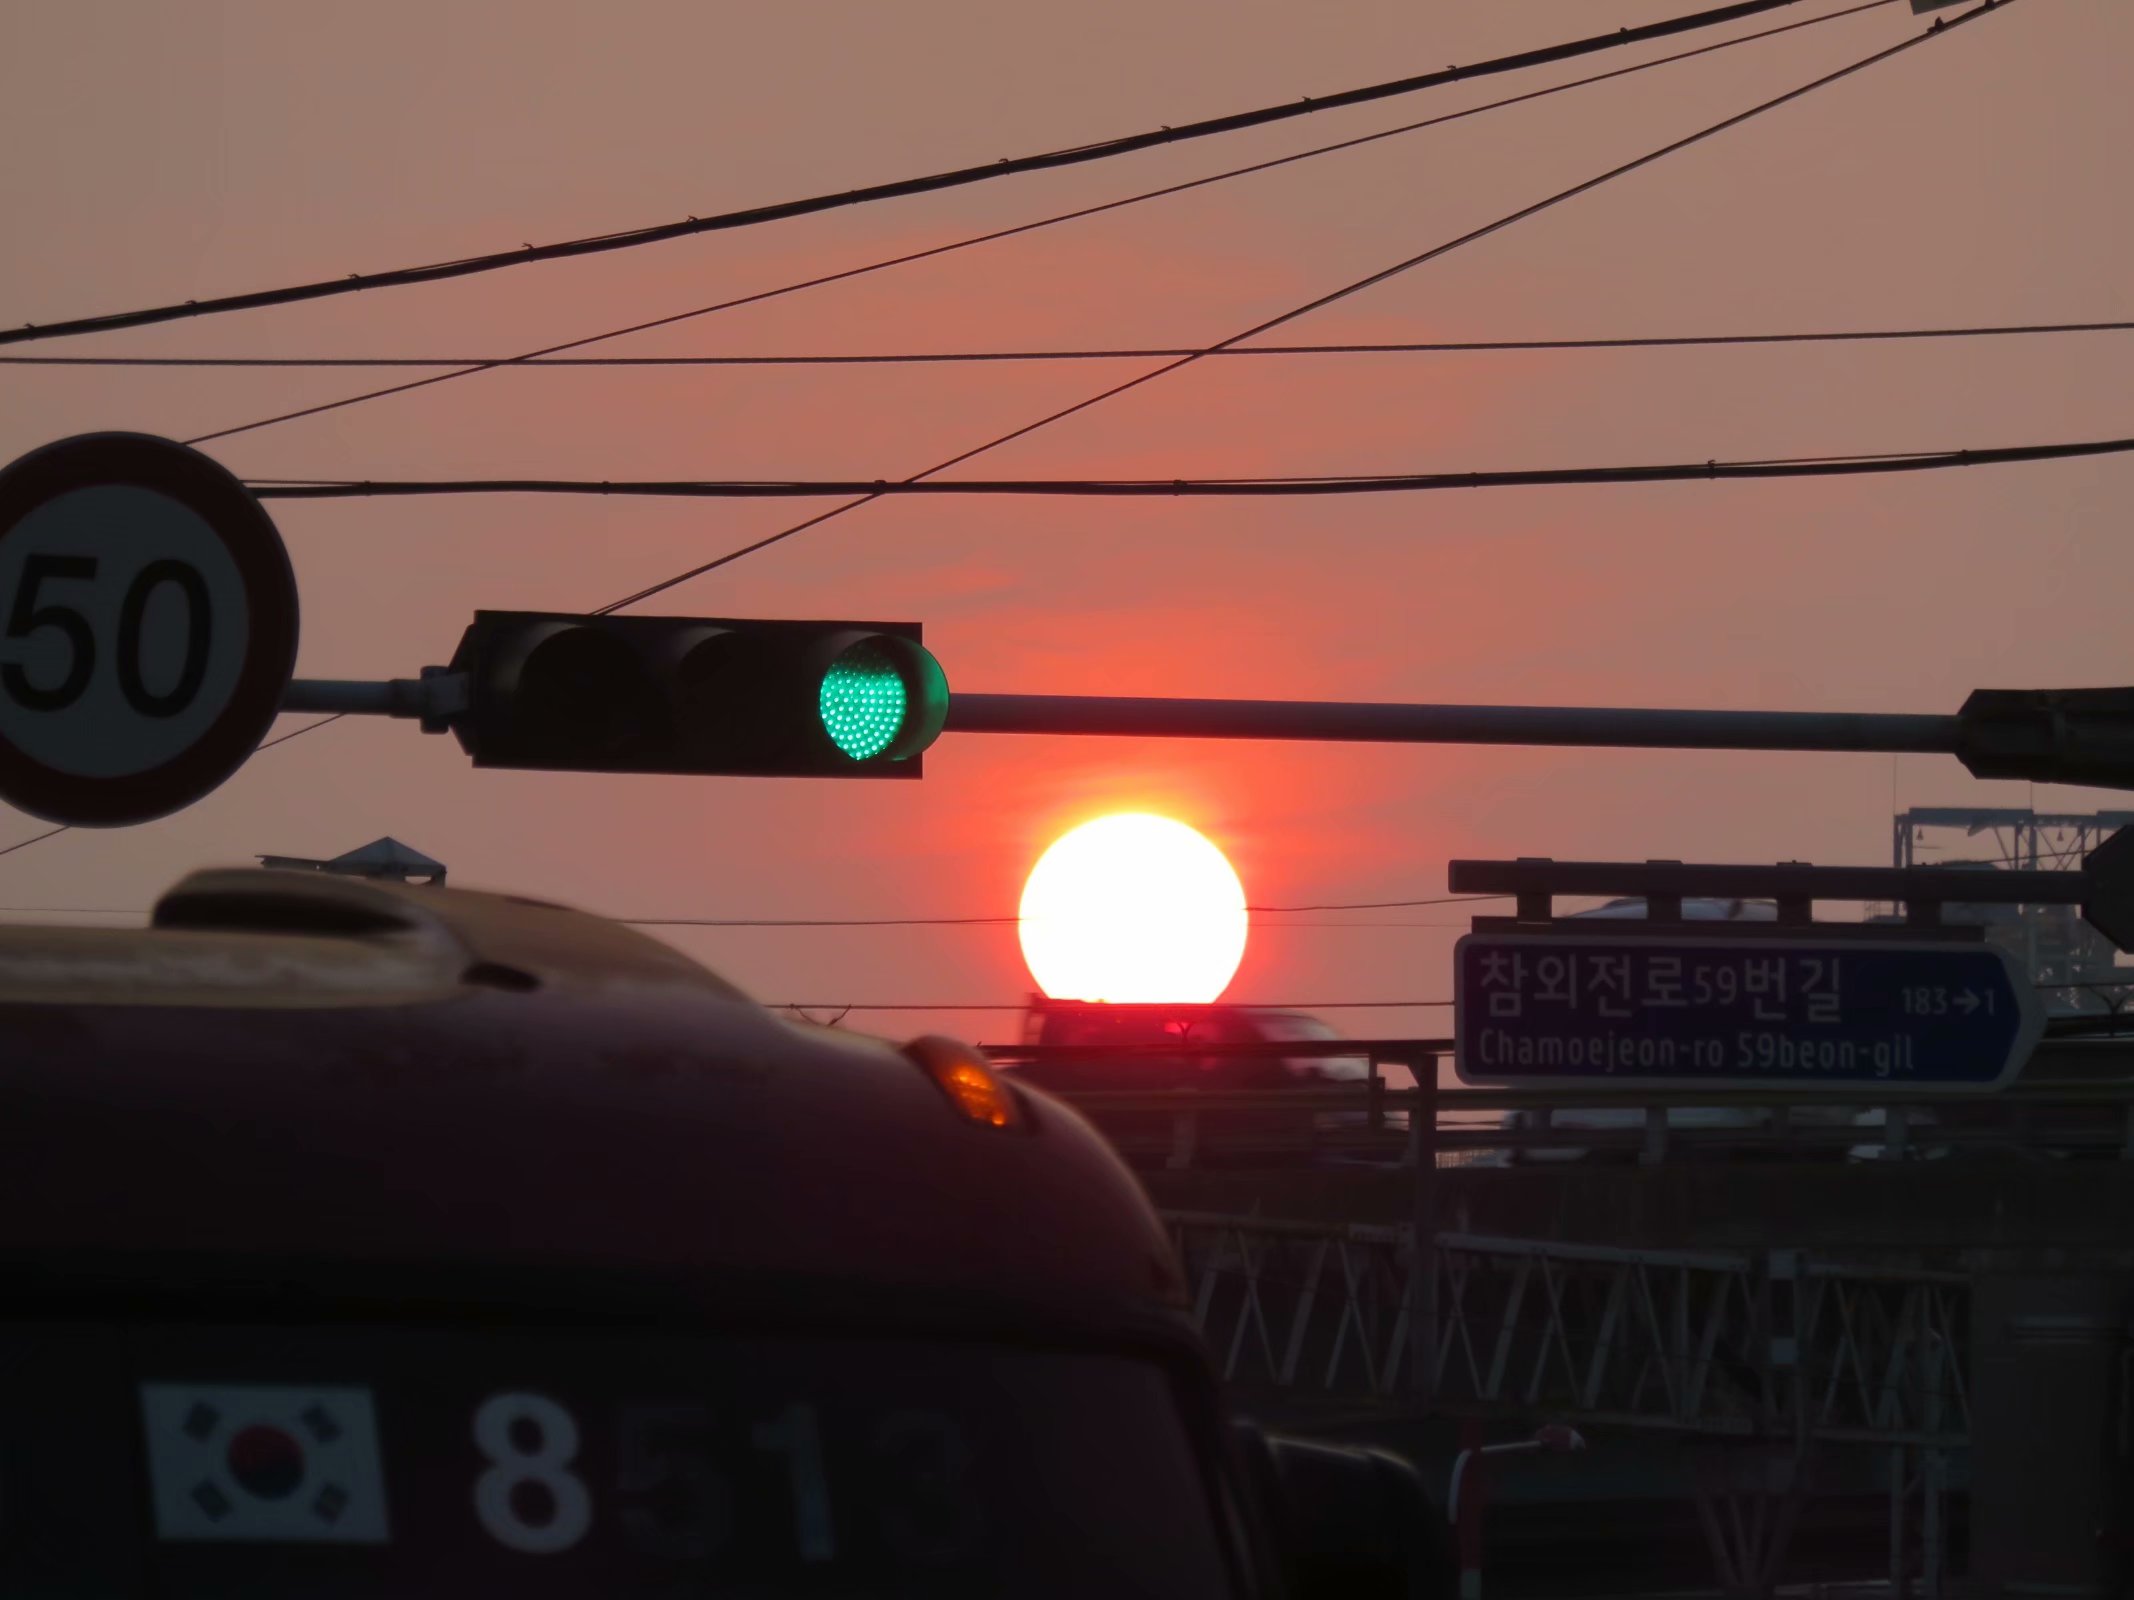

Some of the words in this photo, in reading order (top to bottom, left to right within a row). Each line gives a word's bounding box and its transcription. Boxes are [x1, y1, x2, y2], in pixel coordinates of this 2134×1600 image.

[1, 553, 212, 719] 50
[1480, 951, 1841, 1023] 참외전로59번길
[1480, 1028, 1724, 1073] Chamoejeon-ro
[1738, 1032, 1914, 1078] 59beon-gil
